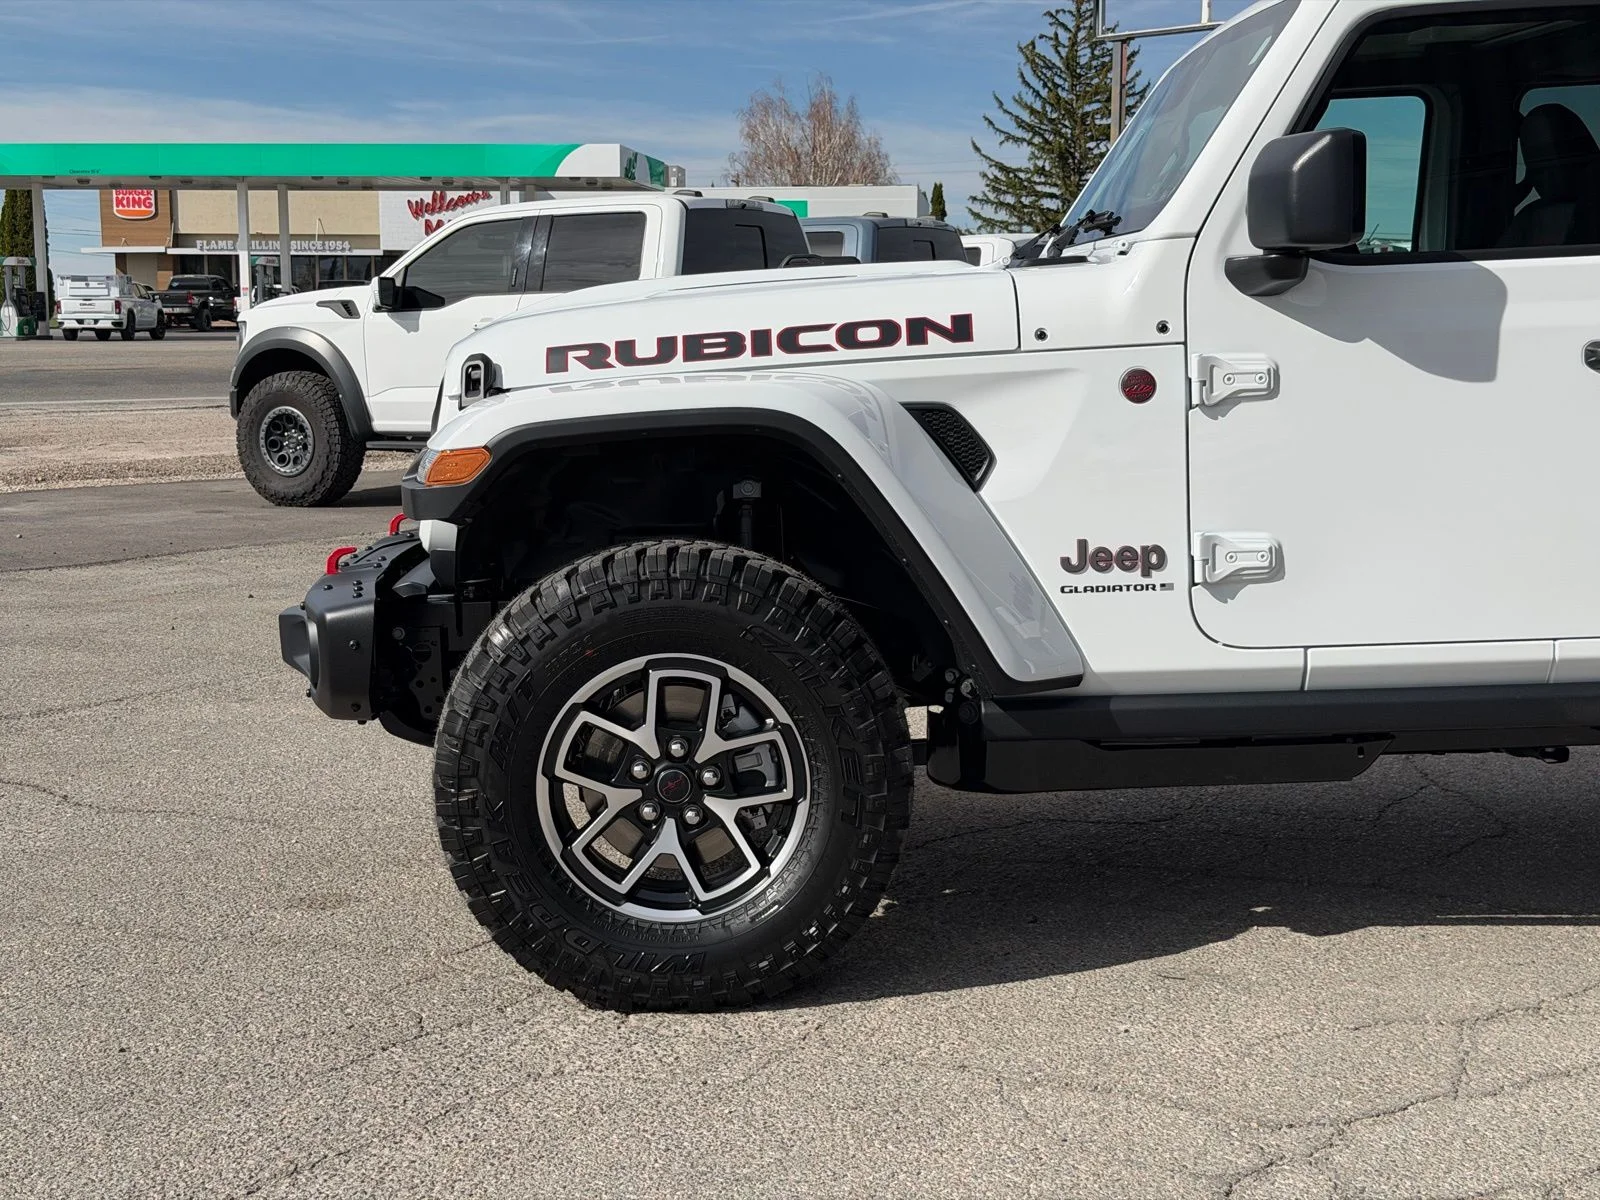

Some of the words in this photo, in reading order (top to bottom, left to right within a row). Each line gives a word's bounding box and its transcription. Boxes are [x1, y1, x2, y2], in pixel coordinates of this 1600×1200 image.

[115, 196, 153, 209] KING
[196, 240, 234, 250] FLAME
[290, 240, 324, 250] SINCE
[325, 240, 350, 250] 1954
[545, 313, 975, 375] RUBICON
[1060, 538, 1168, 578] Jeep
[1060, 583, 1157, 594] GLADIATOR
